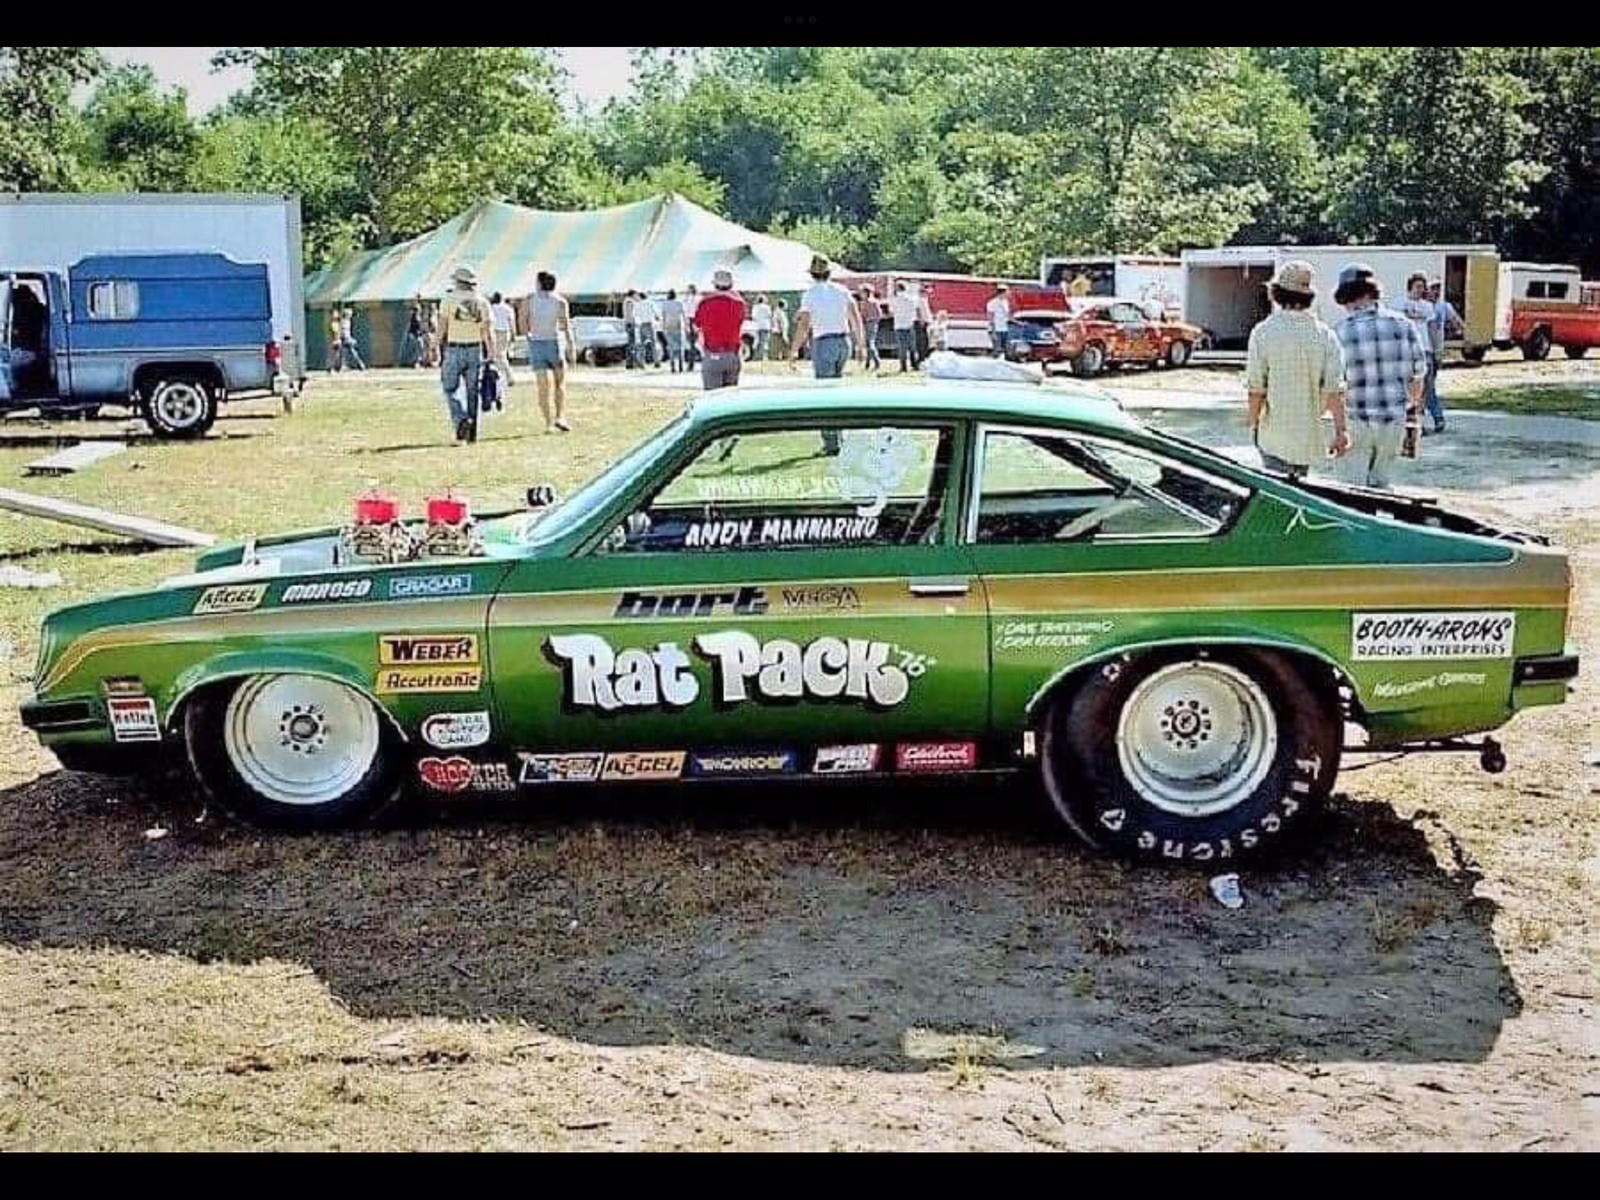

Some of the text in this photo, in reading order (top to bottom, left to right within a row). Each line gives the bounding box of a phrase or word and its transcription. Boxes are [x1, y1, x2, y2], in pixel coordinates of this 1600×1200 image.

[685, 520, 752, 546] ANDY
[281, 579, 372, 602] MOROSO
[383, 637, 473, 661] WEBER
[1358, 644, 1413, 656] RACING
[547, 633, 701, 711] Rat
[694, 631, 909, 706] Pack
